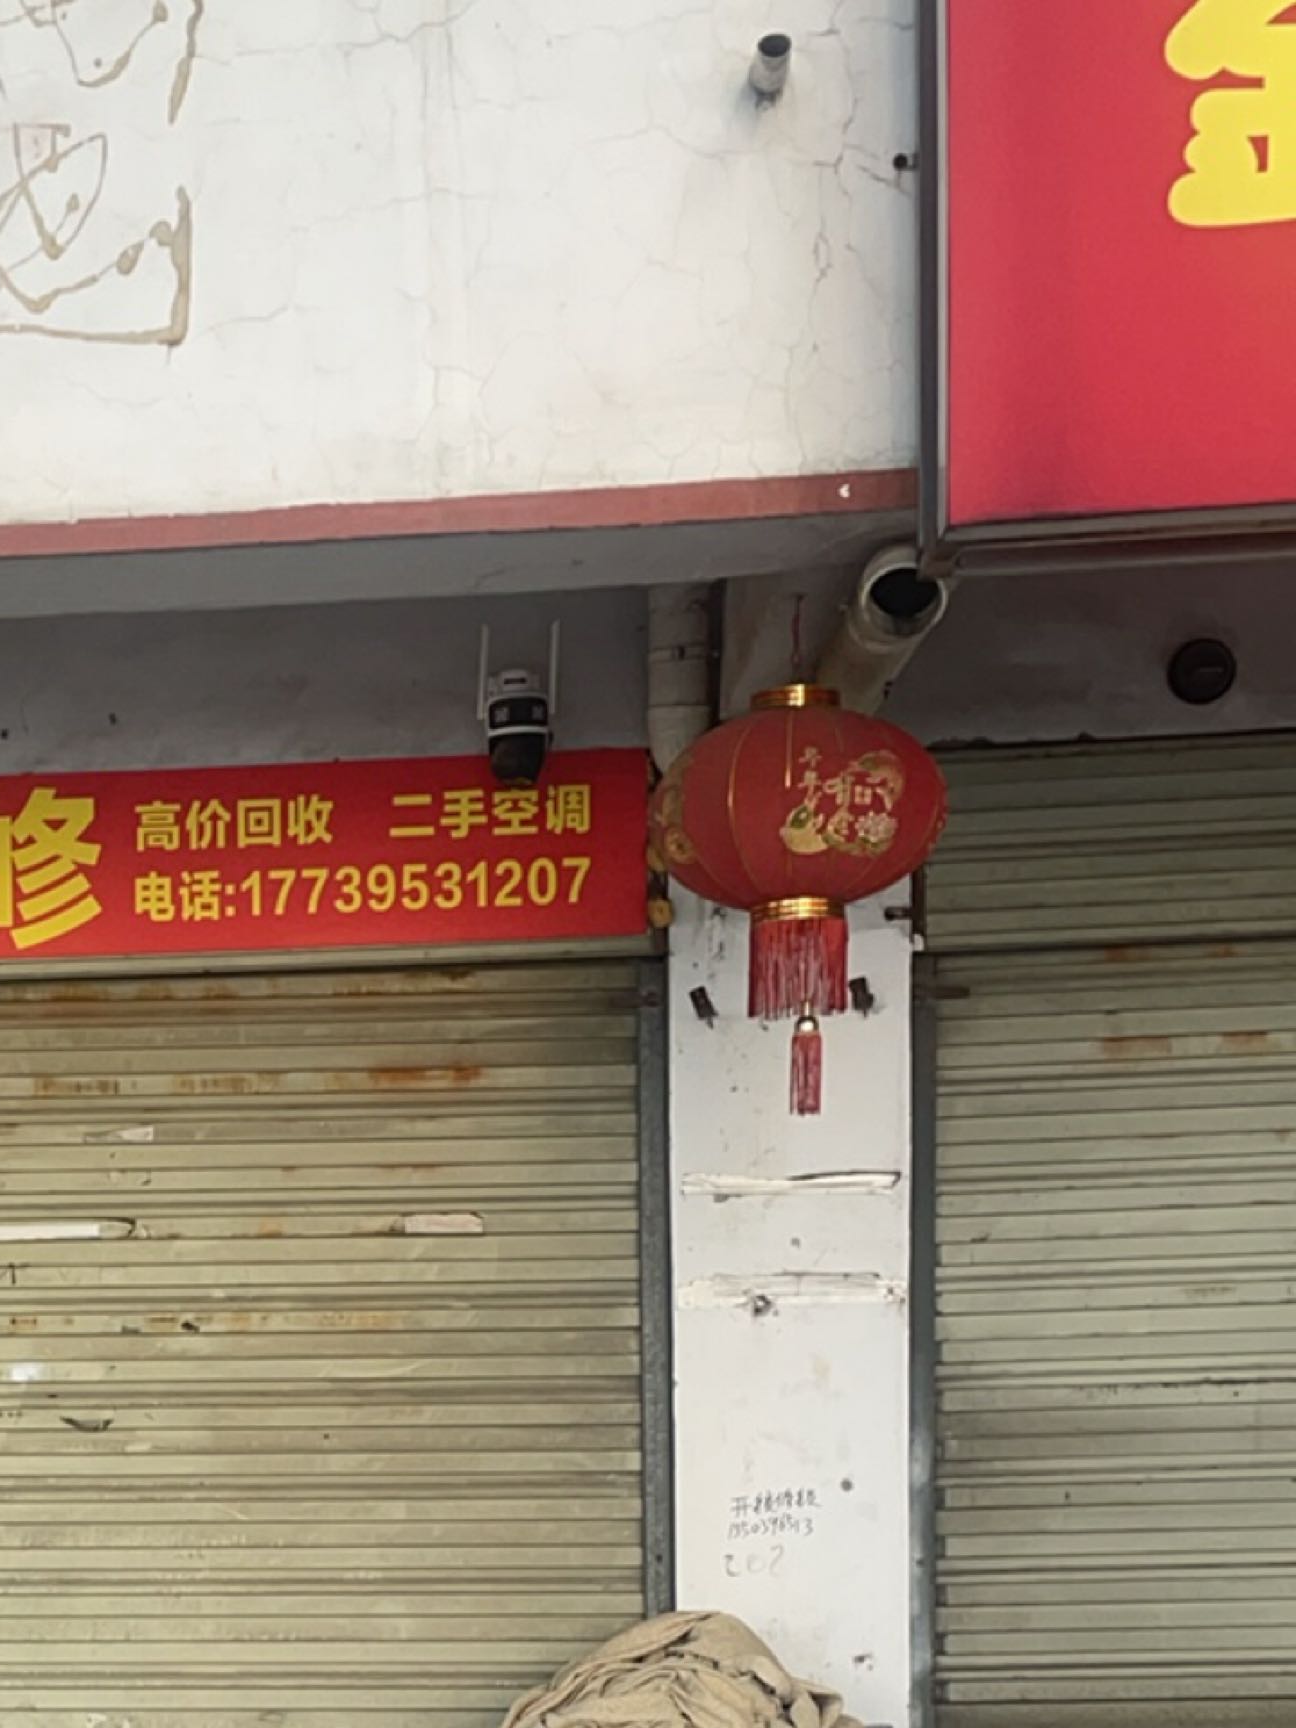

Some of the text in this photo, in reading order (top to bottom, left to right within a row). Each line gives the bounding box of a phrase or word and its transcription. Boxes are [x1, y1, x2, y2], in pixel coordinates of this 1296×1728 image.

[134, 784, 592, 852] 高价回收 二手空调
[134, 857, 592, 922] 电话:17739531207
